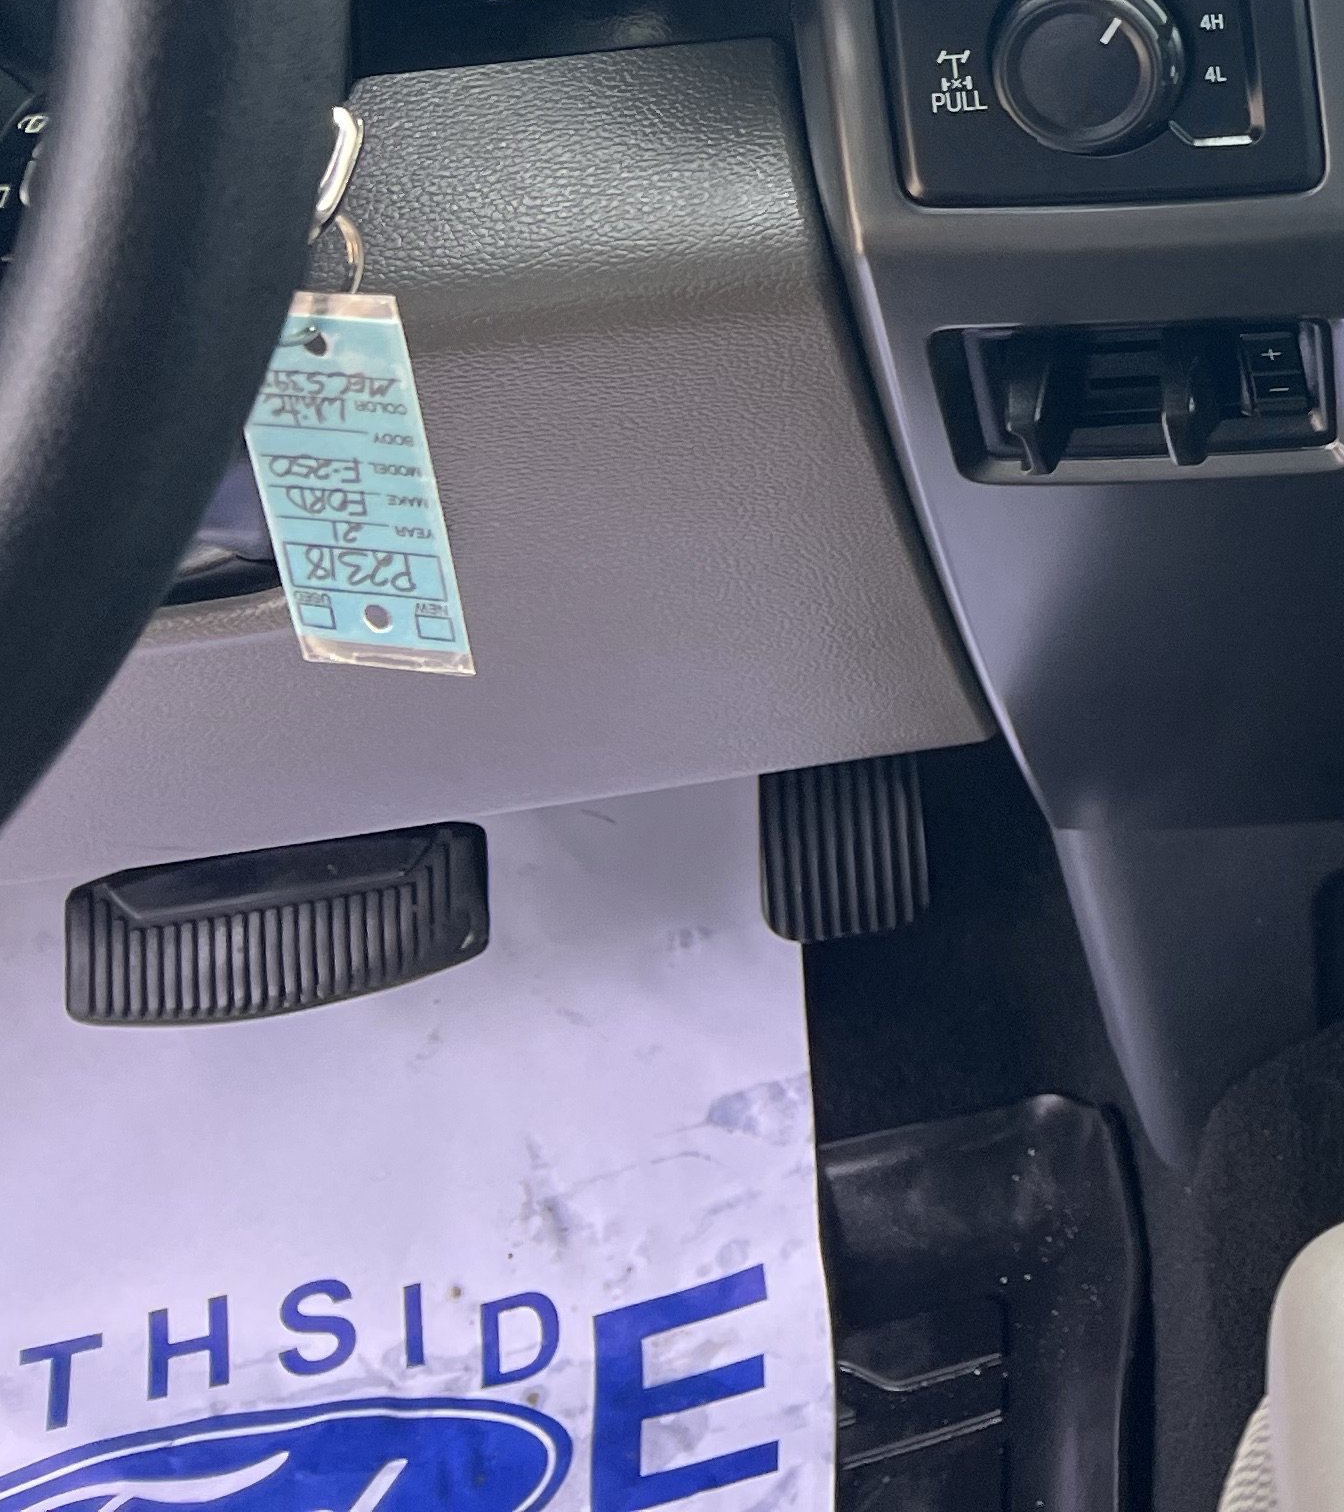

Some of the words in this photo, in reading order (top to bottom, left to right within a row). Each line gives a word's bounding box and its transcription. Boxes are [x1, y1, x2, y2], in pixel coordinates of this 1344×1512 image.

[1200, 13, 1224, 32] 4H
[1204, 66, 1228, 84] 4L
[931, 90, 989, 114] PULL
[263, 394, 347, 426] White
[355, 399, 408, 416] COLOR
[372, 432, 415, 448] BODY
[268, 454, 362, 484] F-250
[368, 462, 422, 479] MODEL
[286, 486, 368, 517] FORD
[386, 493, 430, 509] MAKE
[331, 519, 365, 544] 21
[393, 524, 436, 540] YEAR
[305, 544, 418, 592] P2318
[292, 590, 332, 606] USED
[414, 602, 449, 618] NEW
